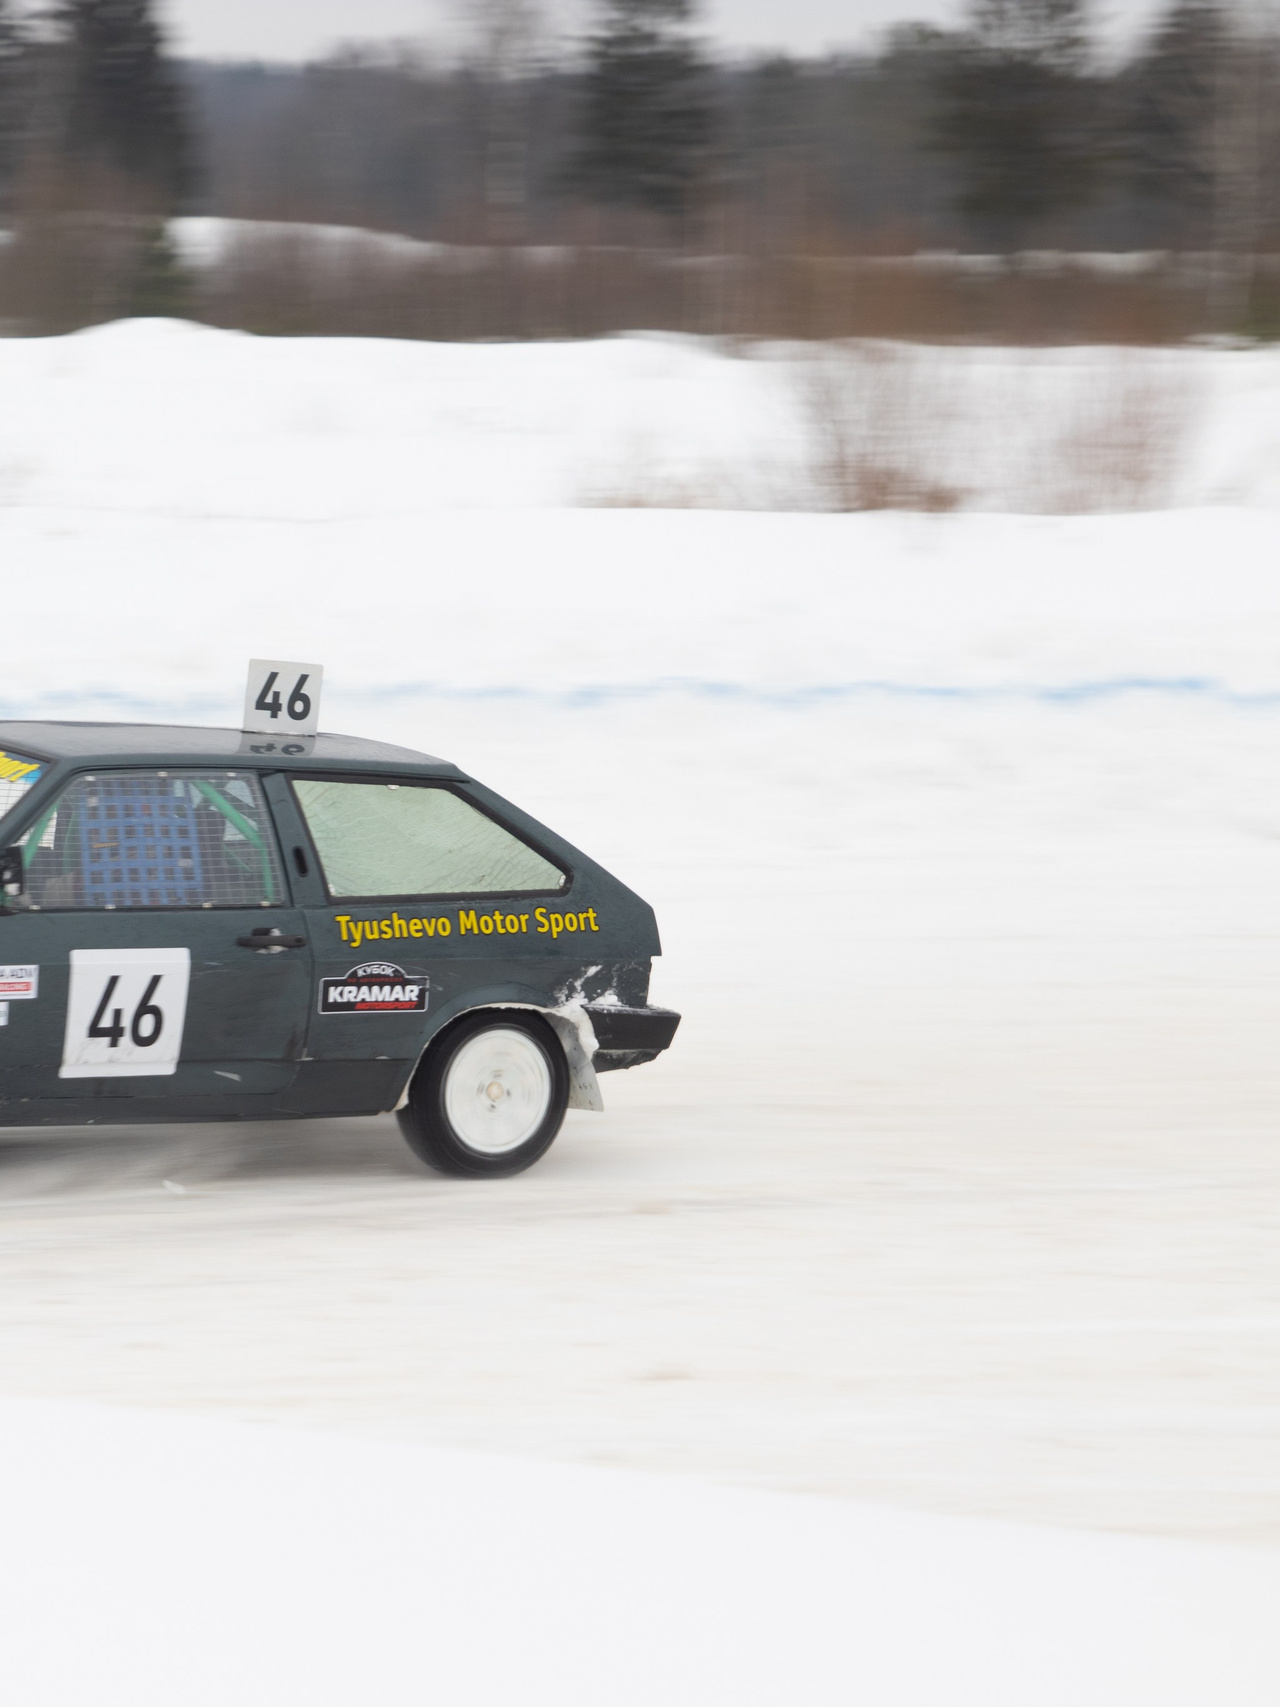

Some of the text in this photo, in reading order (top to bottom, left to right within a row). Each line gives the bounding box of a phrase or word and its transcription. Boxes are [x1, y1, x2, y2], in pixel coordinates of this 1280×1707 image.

[254, 671, 311, 721] 46
[335, 907, 600, 947] Tyushevo Motor Sport
[86, 974, 165, 1048] 46
[327, 984, 420, 1003] KRAMAR
